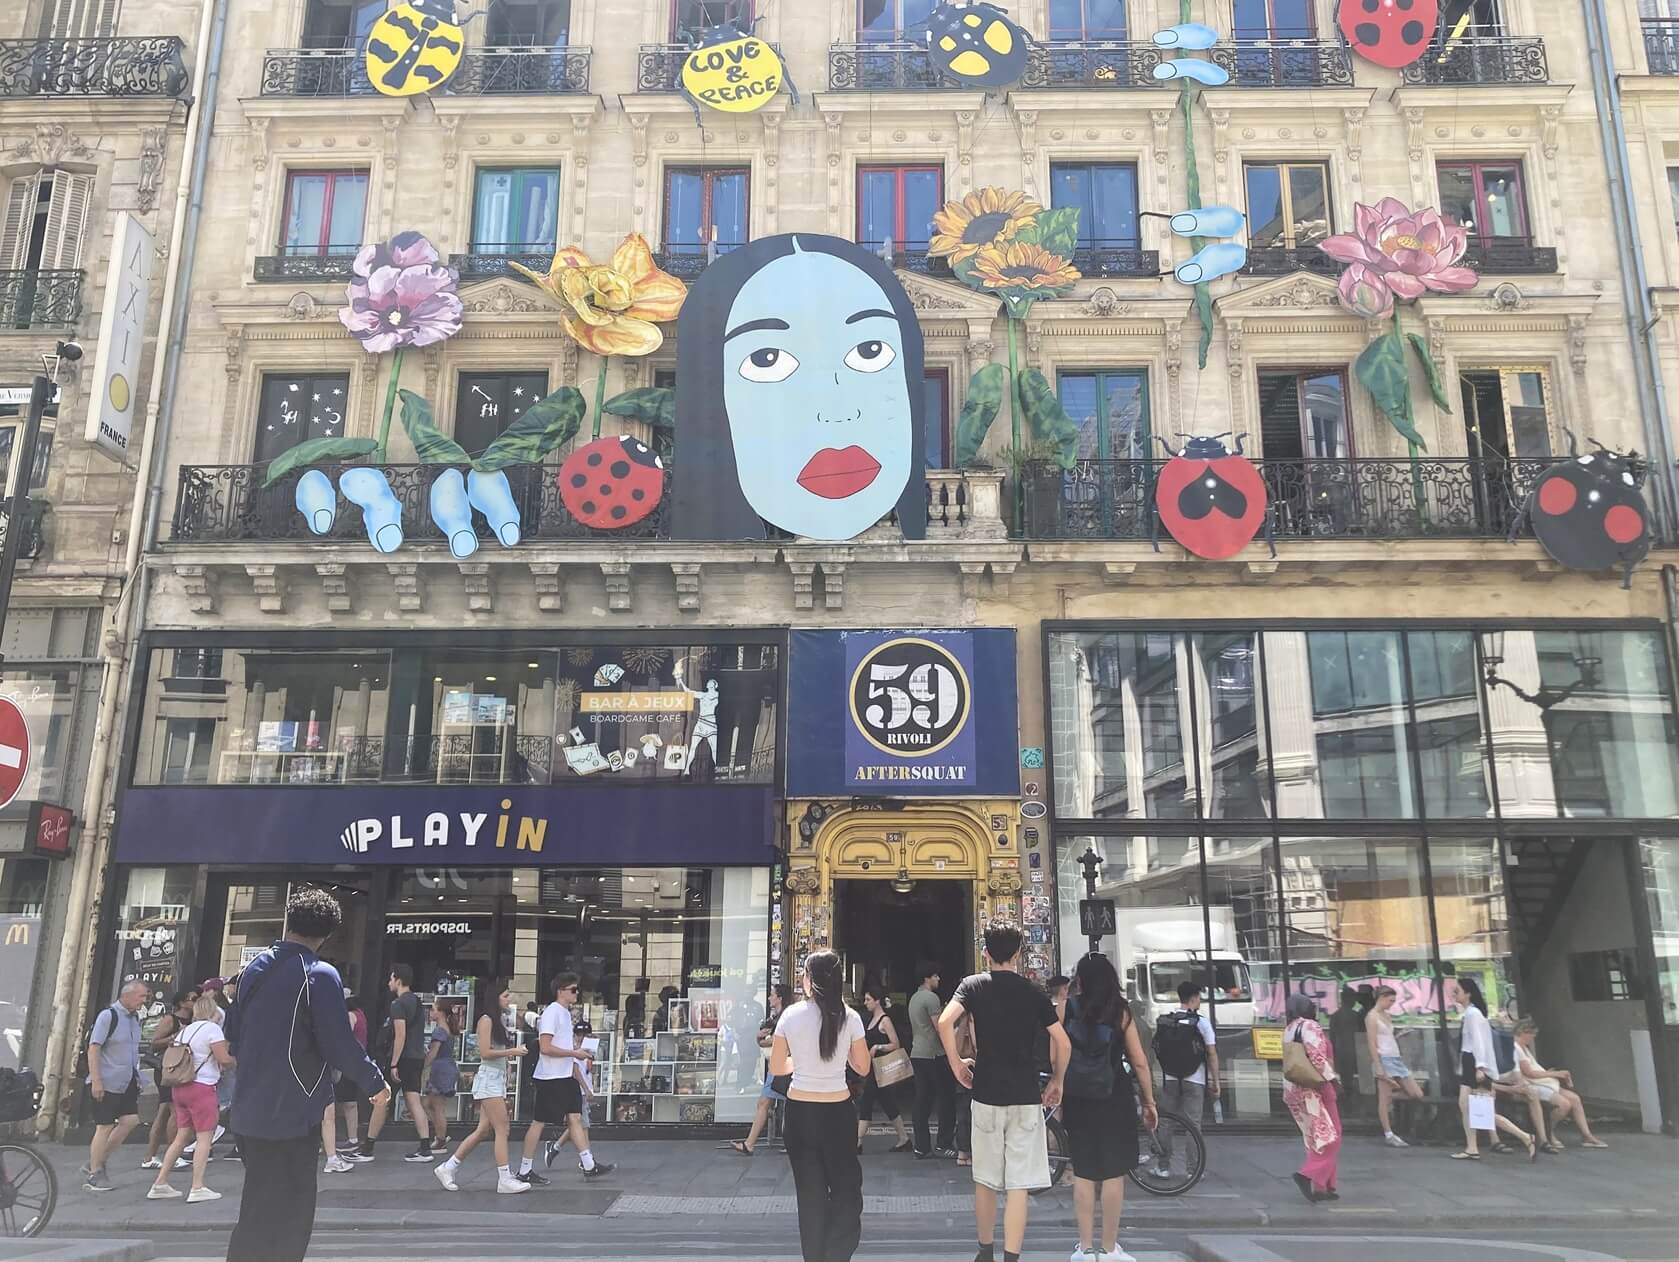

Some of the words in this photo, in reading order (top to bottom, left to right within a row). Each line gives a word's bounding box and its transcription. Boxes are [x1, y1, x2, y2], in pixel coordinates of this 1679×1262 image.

[690, 41, 760, 72] LOVE
[726, 65, 749, 83] &
[698, 75, 777, 104] PEACE
[100, 421, 126, 449] FRANCE
[589, 697, 623, 709] BAR
[627, 694, 641, 708] À
[644, 696, 686, 709] JEUX
[865, 663, 958, 729] 59
[590, 714, 654, 724] BOARDGAME
[887, 733, 931, 745] RIVOLI
[854, 766, 967, 780] AFTERSQUAT
